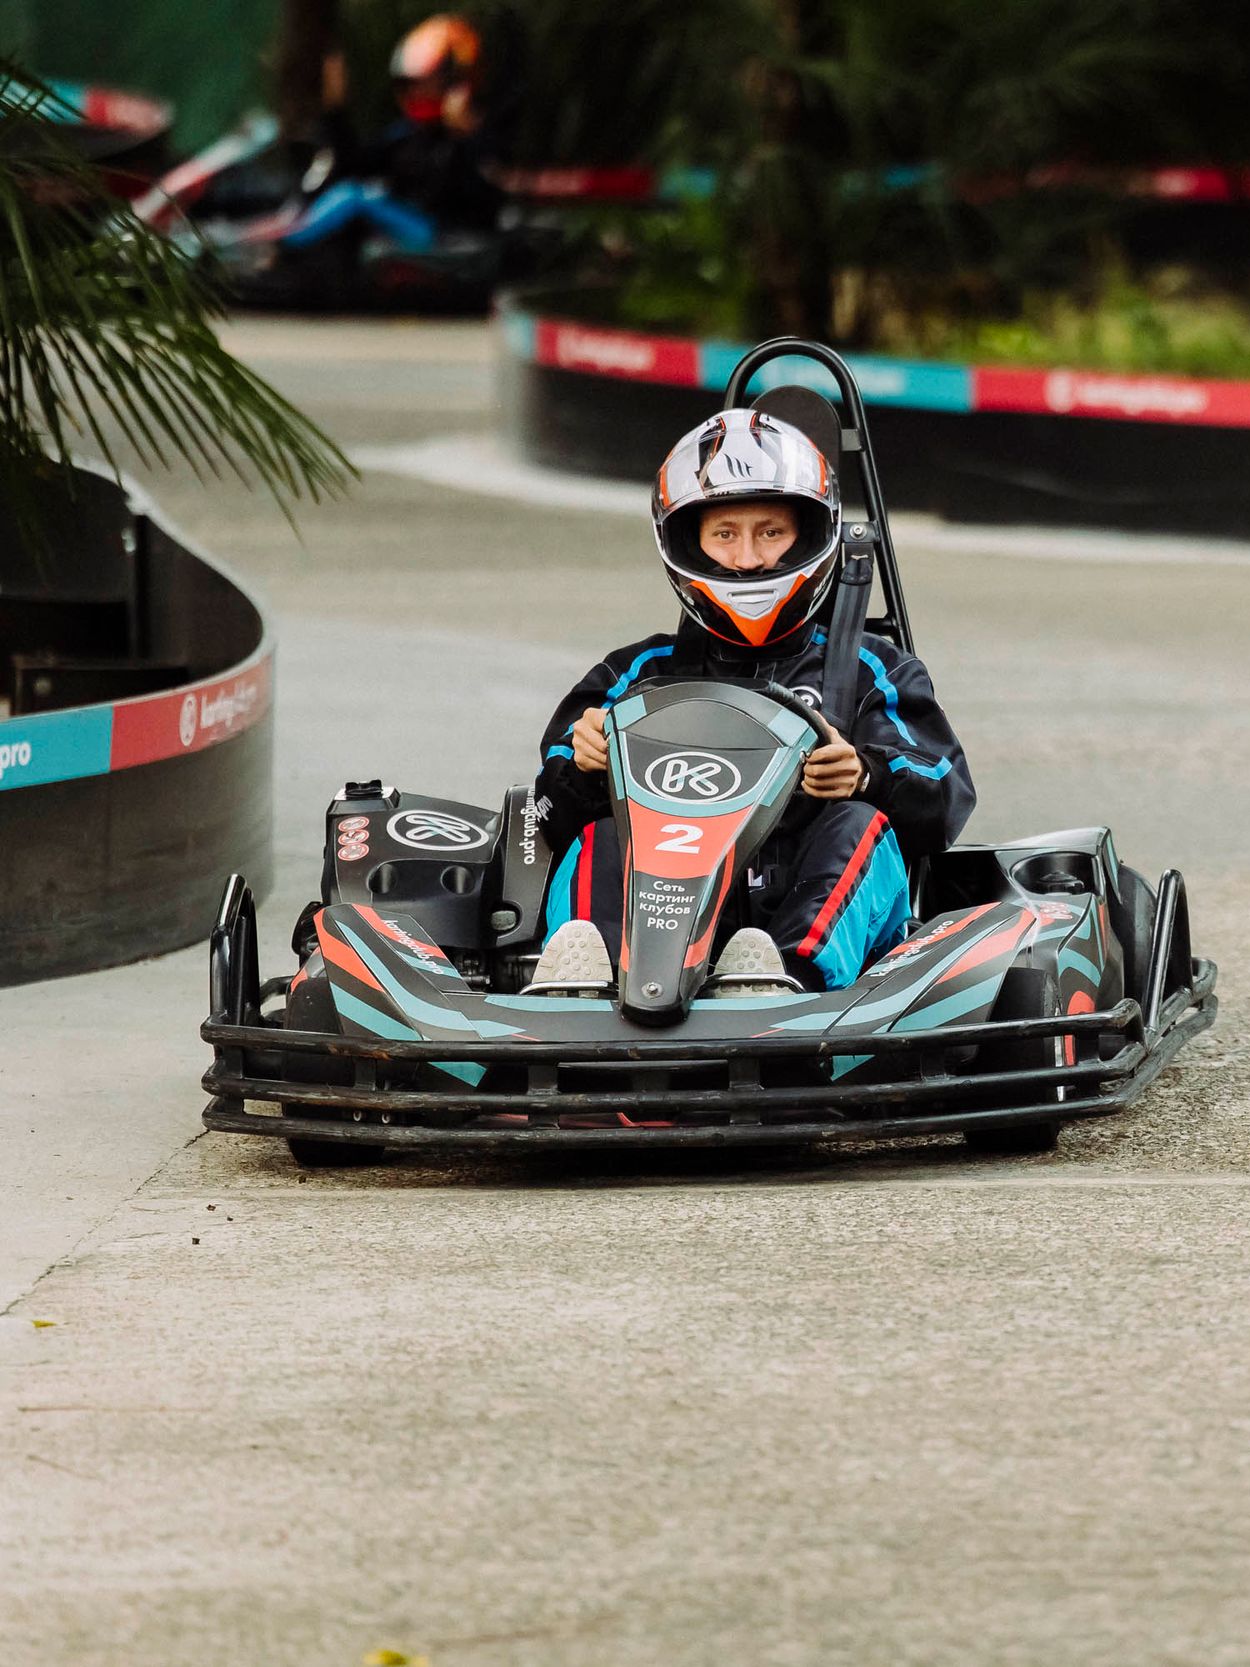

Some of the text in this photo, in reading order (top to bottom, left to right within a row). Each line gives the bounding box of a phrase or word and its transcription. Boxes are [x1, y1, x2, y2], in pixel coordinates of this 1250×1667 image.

[654, 823, 704, 854] 2
[653, 881, 685, 892] Сеть
[639, 891, 696, 904] картинг
[639, 902, 691, 916] клубов
[647, 917, 679, 930] PRO
